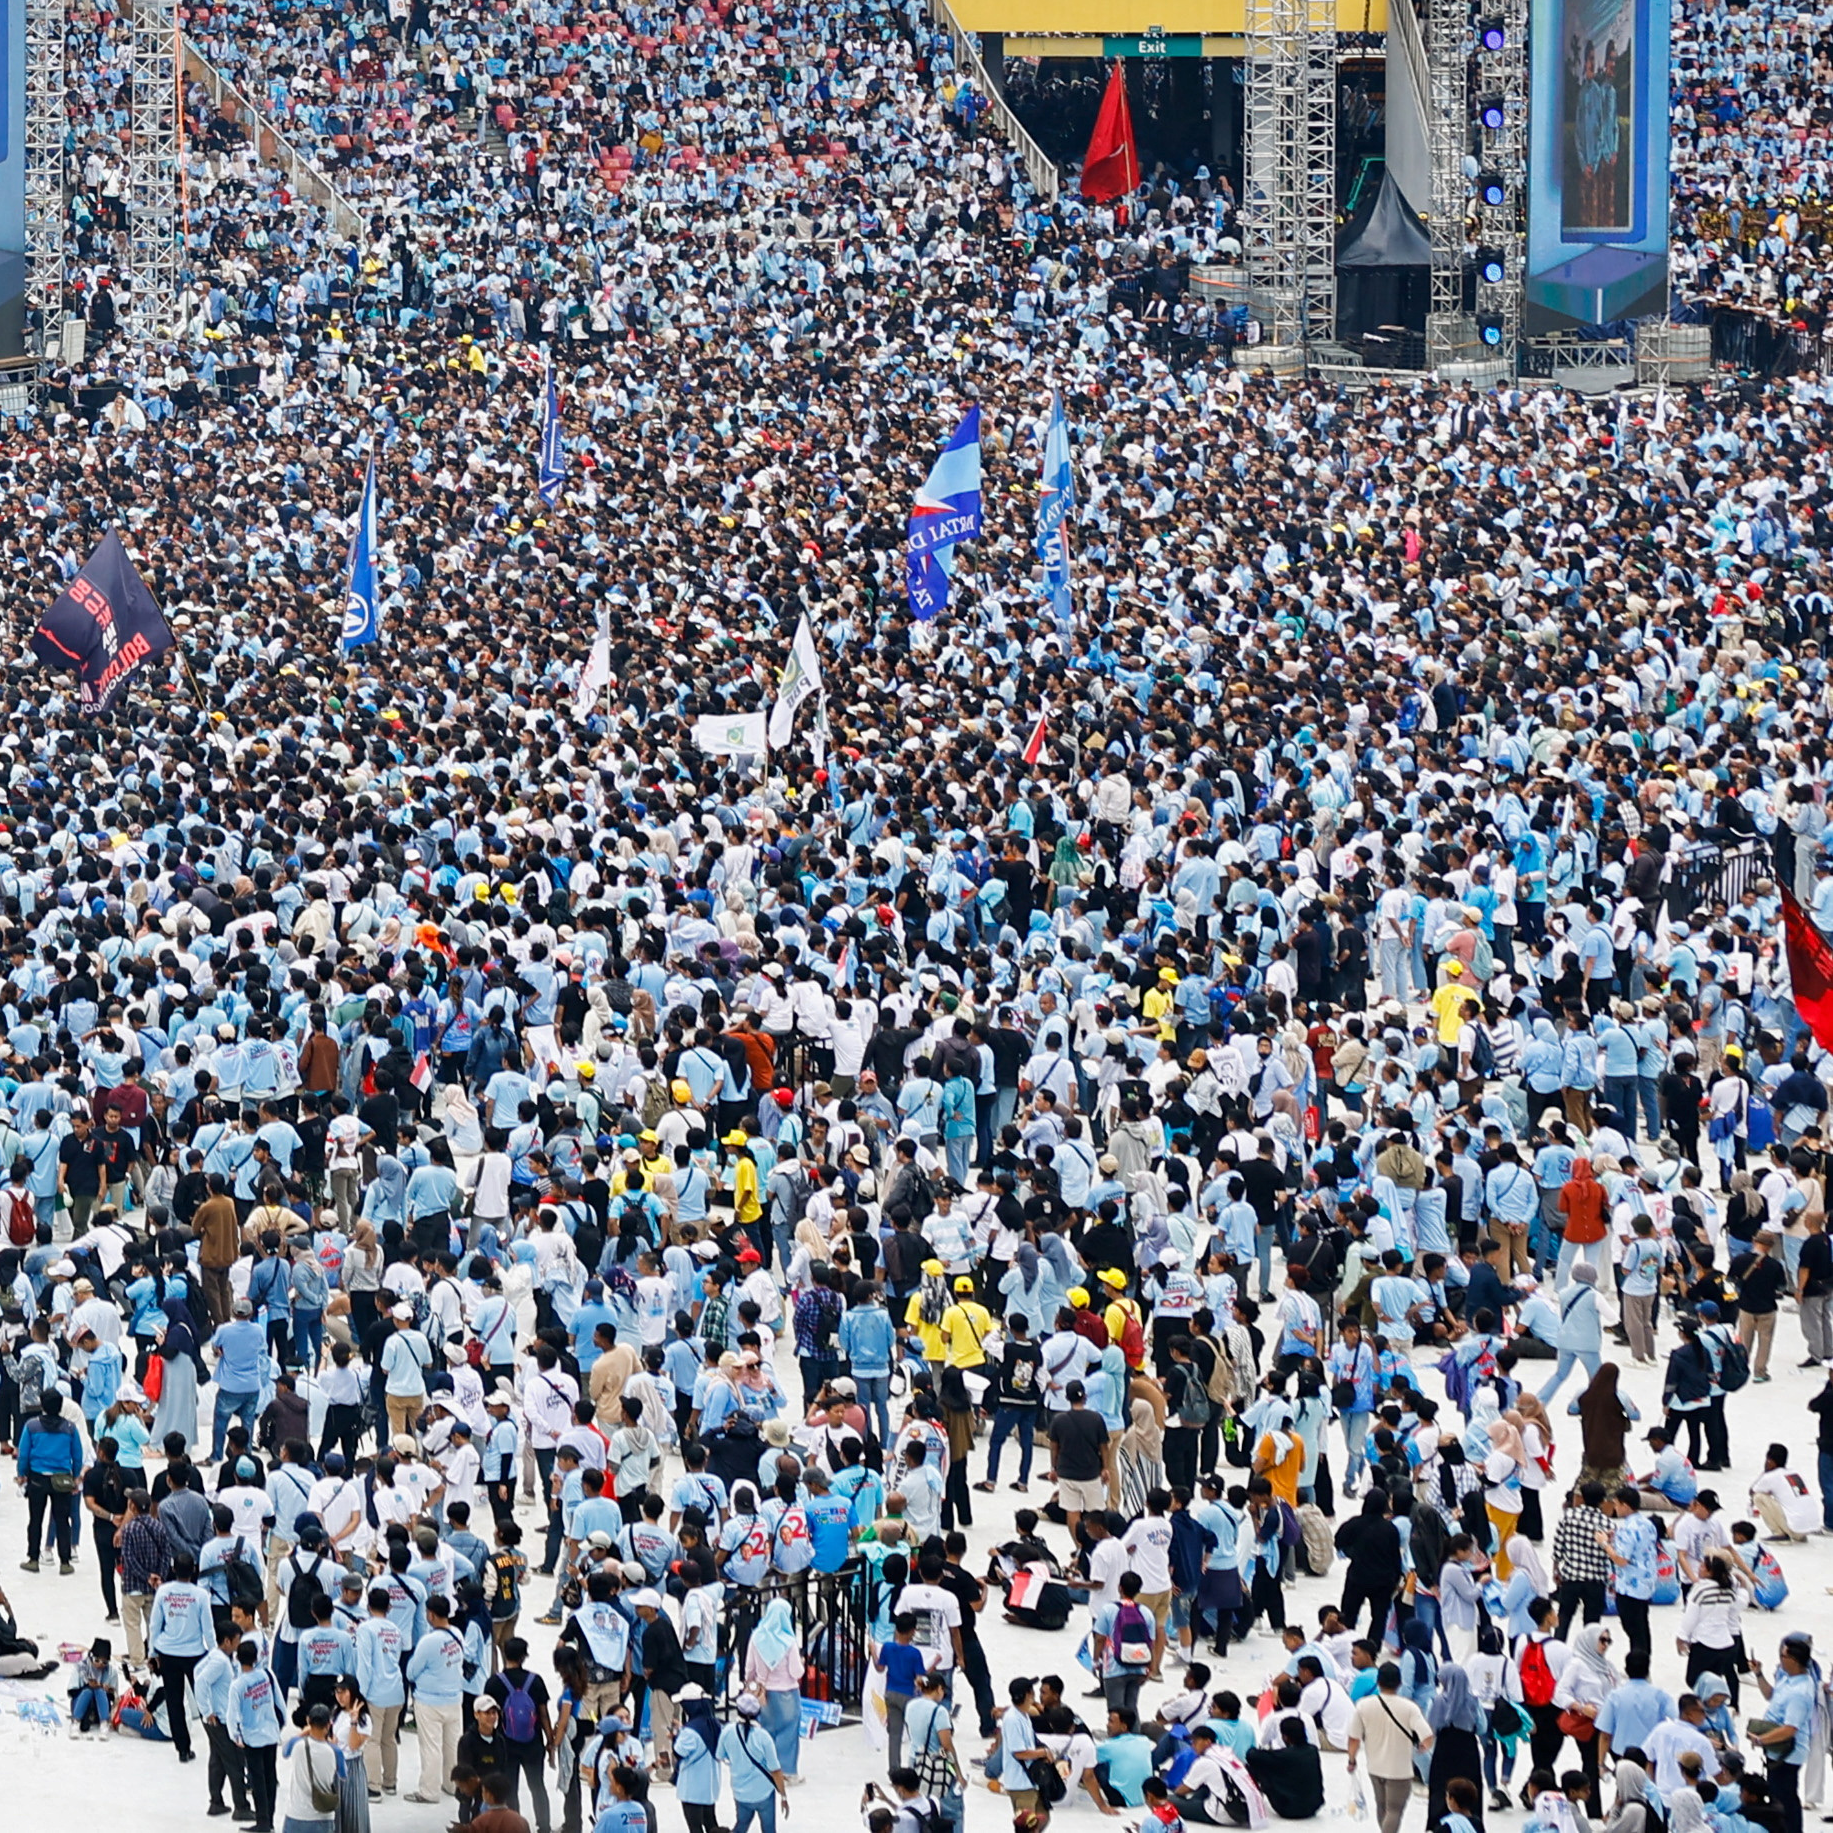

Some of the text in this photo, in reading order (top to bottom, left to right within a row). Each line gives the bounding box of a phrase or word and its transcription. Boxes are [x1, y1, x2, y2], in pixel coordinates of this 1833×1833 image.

[1138, 41, 1167, 54] Exit
[789, 1516, 807, 1539] 2
[752, 1532, 766, 1556] 2
